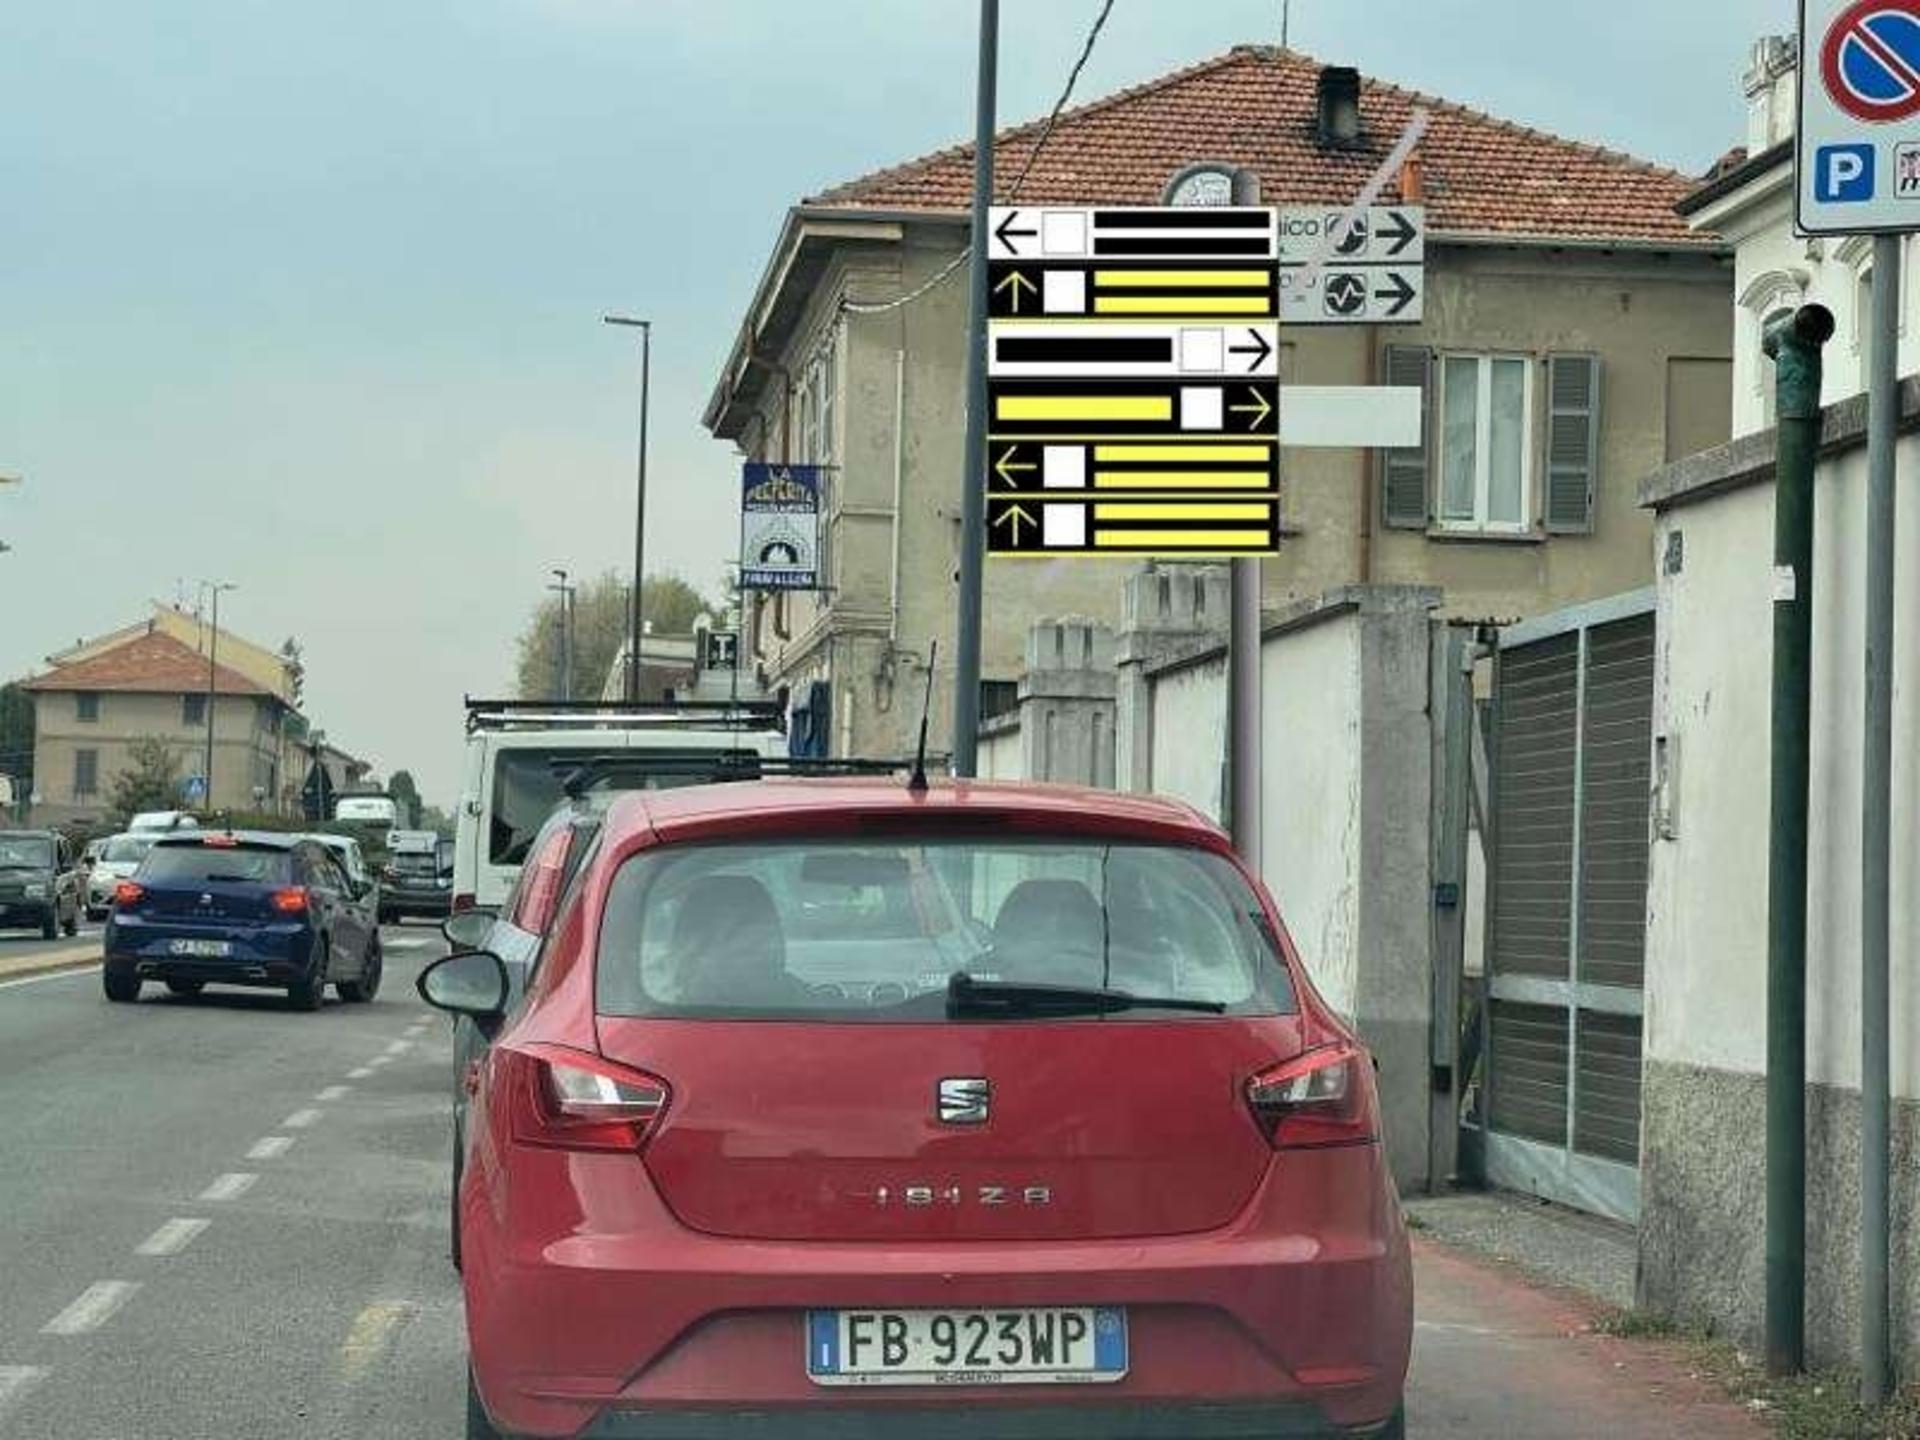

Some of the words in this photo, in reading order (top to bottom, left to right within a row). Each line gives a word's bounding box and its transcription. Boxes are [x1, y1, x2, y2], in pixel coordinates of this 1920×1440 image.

[1828, 153, 1863, 196] P
[715, 636, 733, 660] T
[848, 1314, 908, 1367] FB
[931, 1312, 1087, 1366] 923WP
